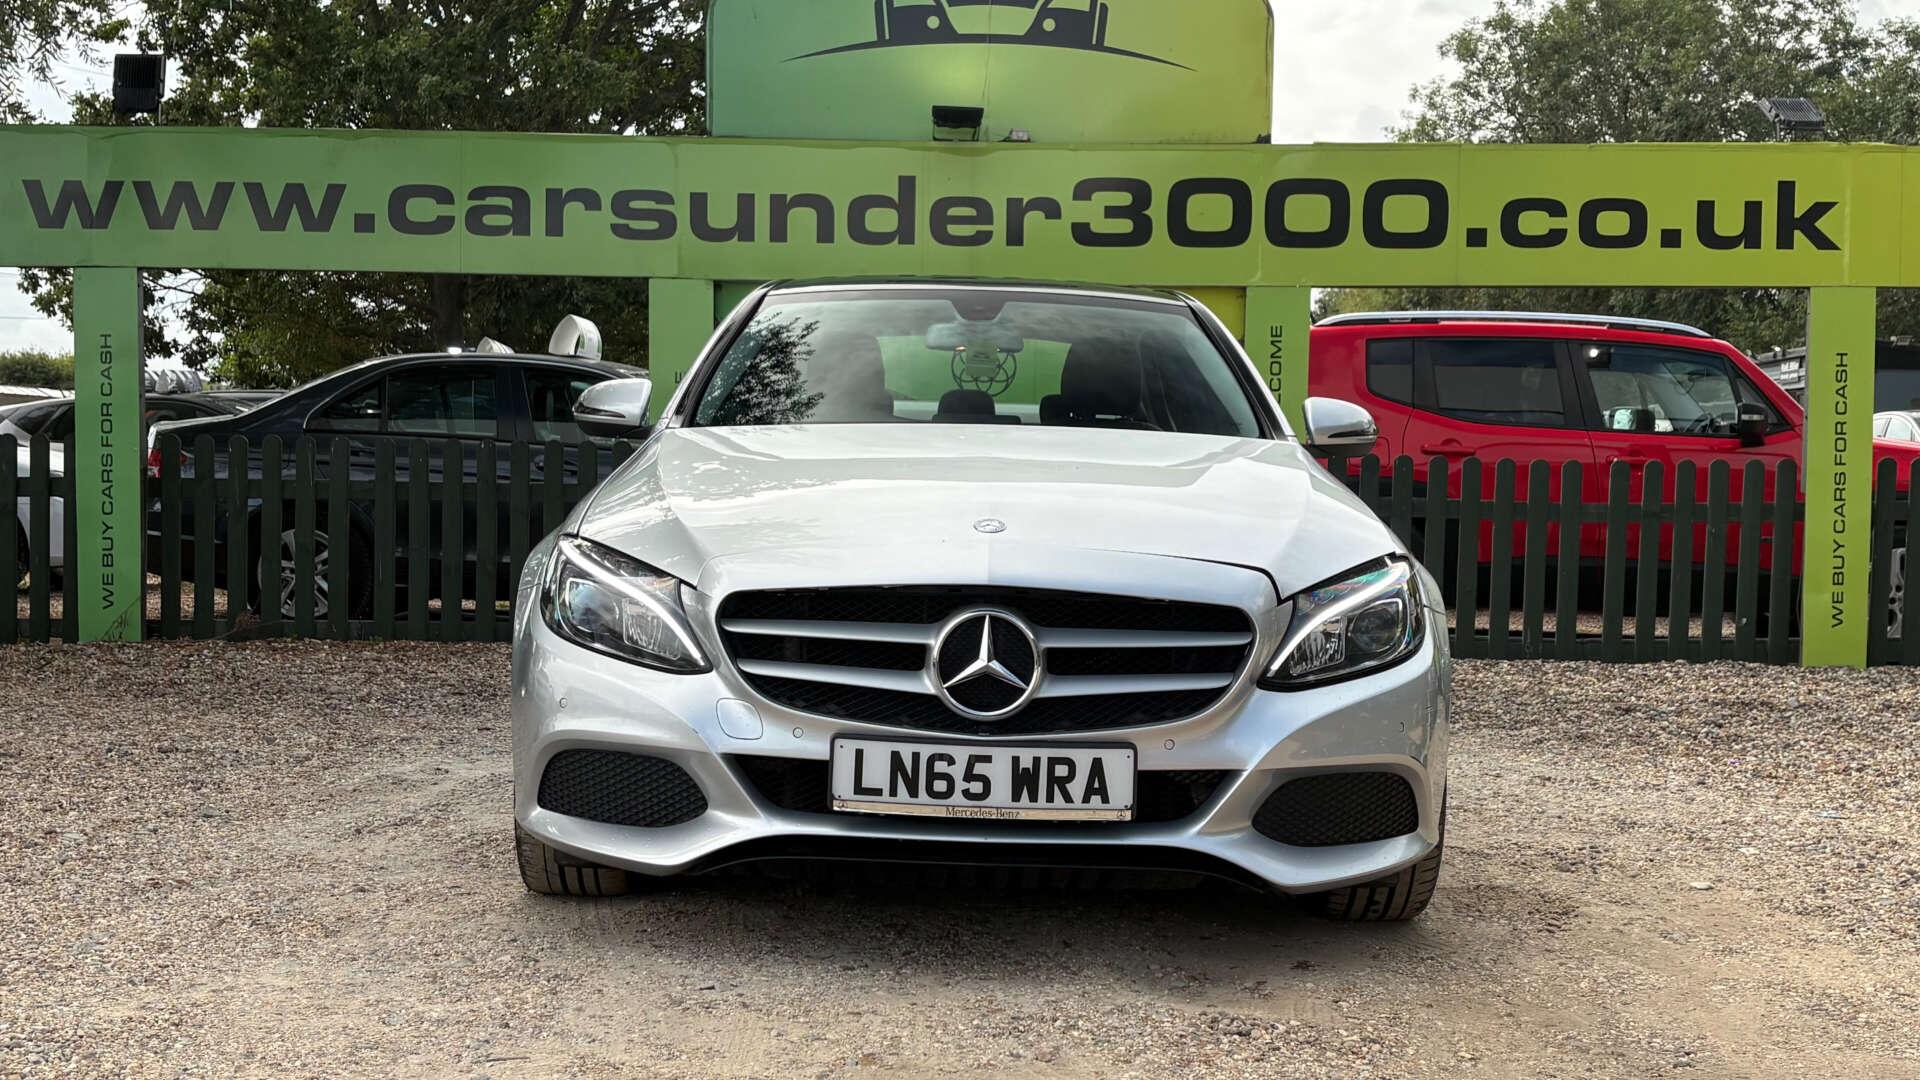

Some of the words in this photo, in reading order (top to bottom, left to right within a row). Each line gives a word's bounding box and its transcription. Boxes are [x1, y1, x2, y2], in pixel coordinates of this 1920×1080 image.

[21, 175, 1842, 252] www.carsunder3000.co.uk
[99, 333, 113, 397] CASH
[1834, 352, 1849, 416] CASH
[100, 402, 114, 448] FOR
[1834, 420, 1848, 466] FOR
[100, 452, 114, 516] CARS
[1833, 471, 1847, 534] CARS
[101, 520, 115, 568] BUY
[1832, 538, 1846, 586] BUY
[101, 572, 115, 611] WE
[1831, 591, 1845, 629] WE
[853, 747, 993, 802] LN65
[1010, 755, 1111, 805] WRA
[945, 806, 1021, 819] Mercedes-Benz
